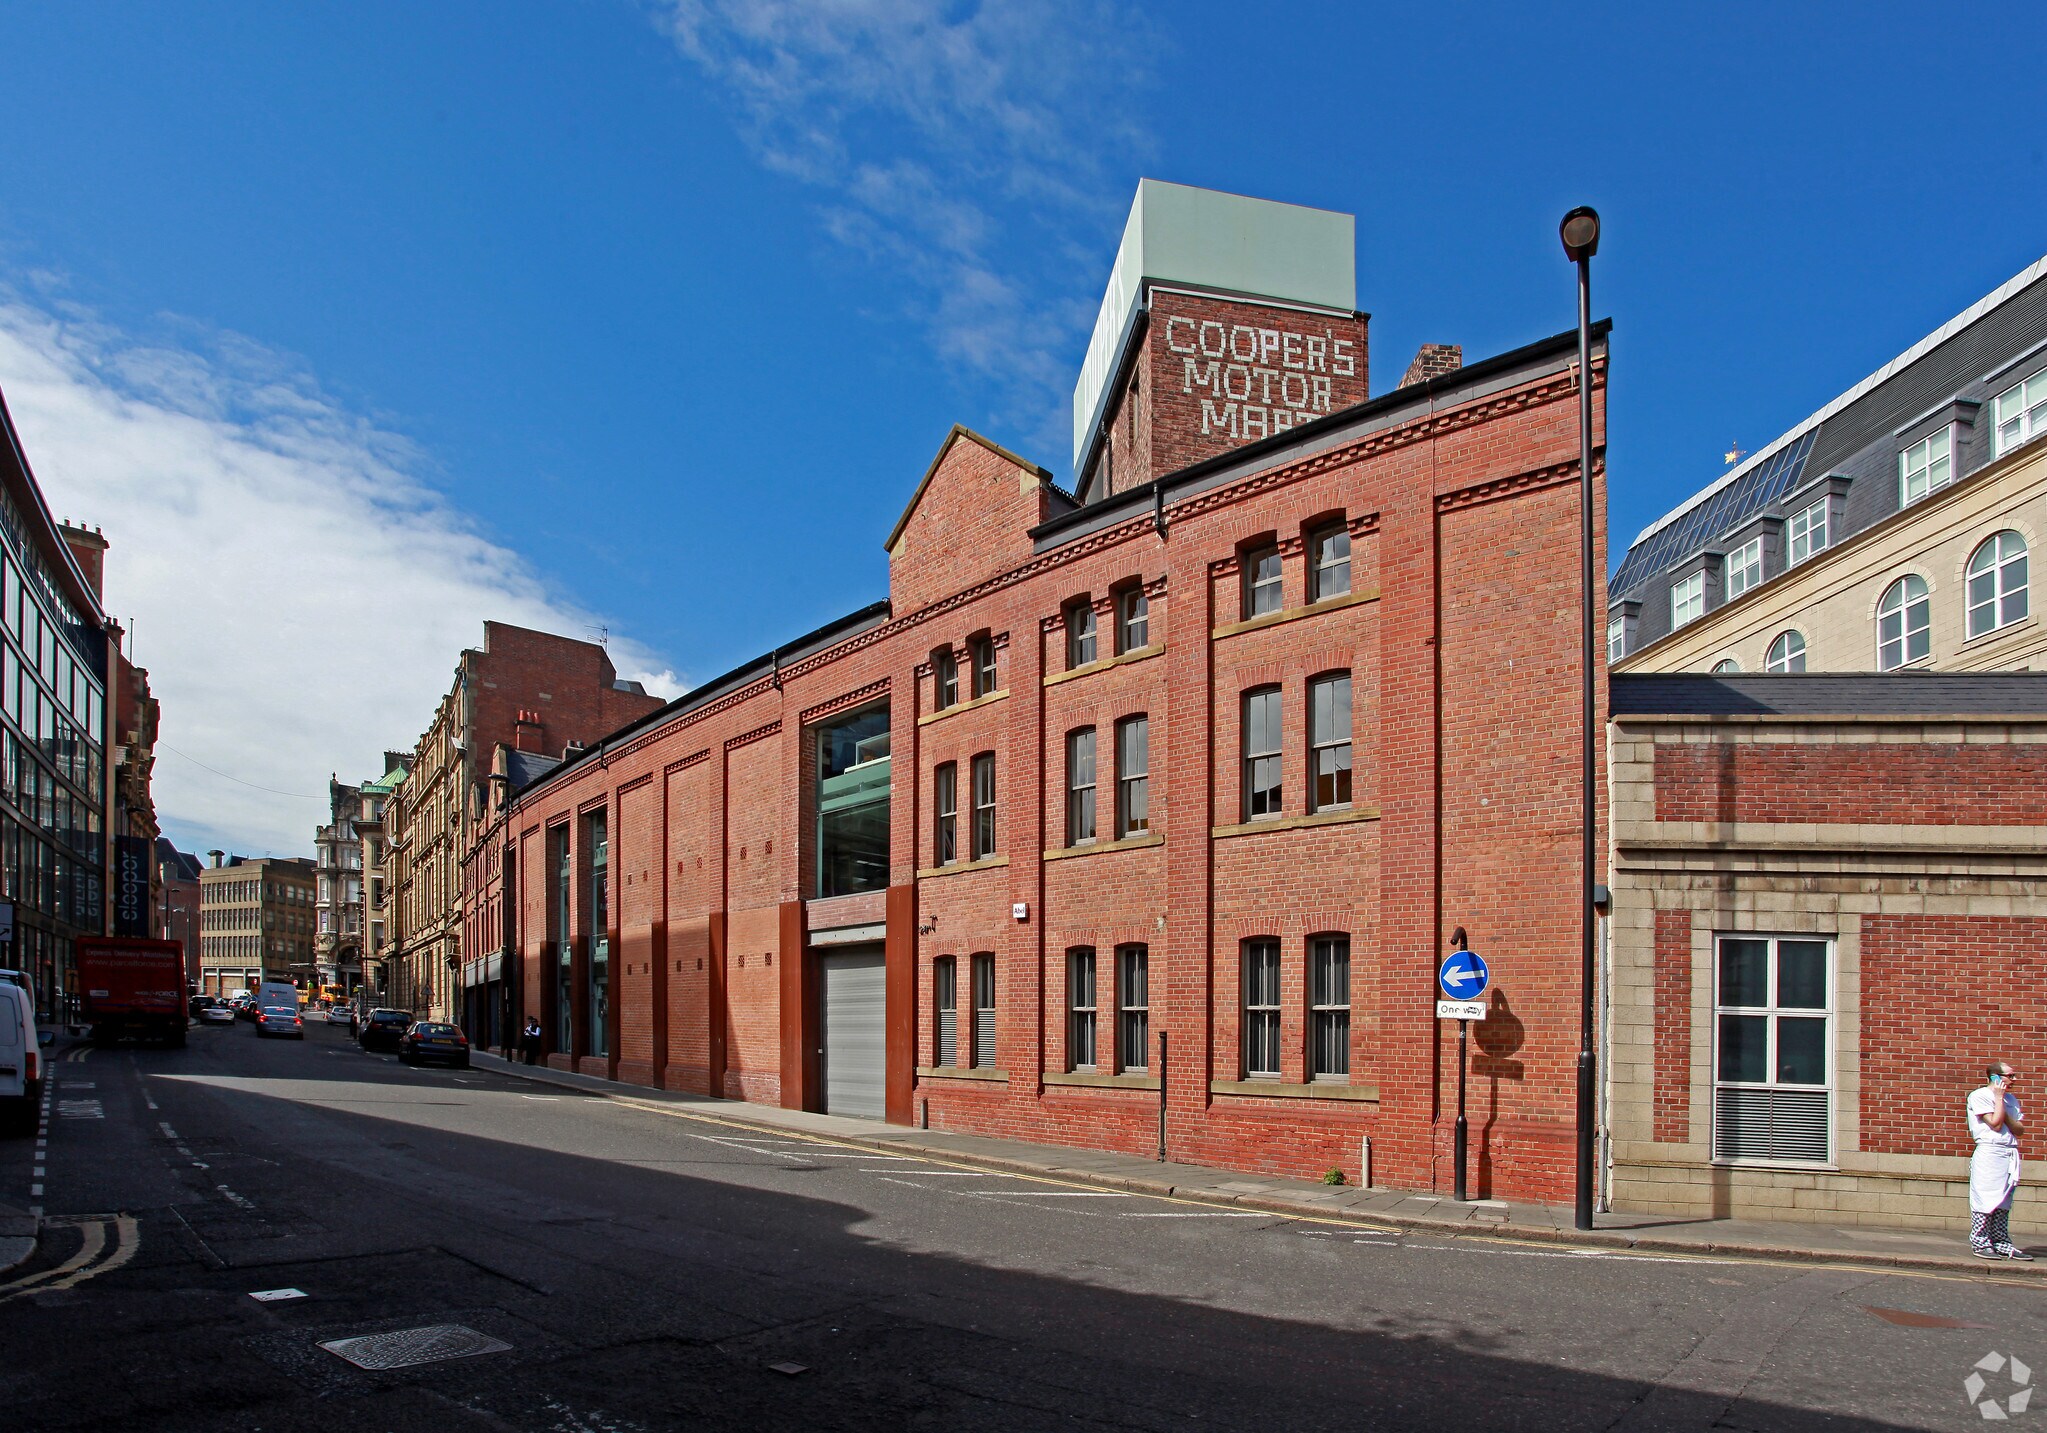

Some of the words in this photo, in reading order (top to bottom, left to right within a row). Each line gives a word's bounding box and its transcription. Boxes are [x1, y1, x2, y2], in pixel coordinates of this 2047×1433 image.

[1165, 315, 1355, 376] COOPER'S
[1182, 357, 1332, 412] MOTOR
[1440, 1005, 1460, 1014] One
